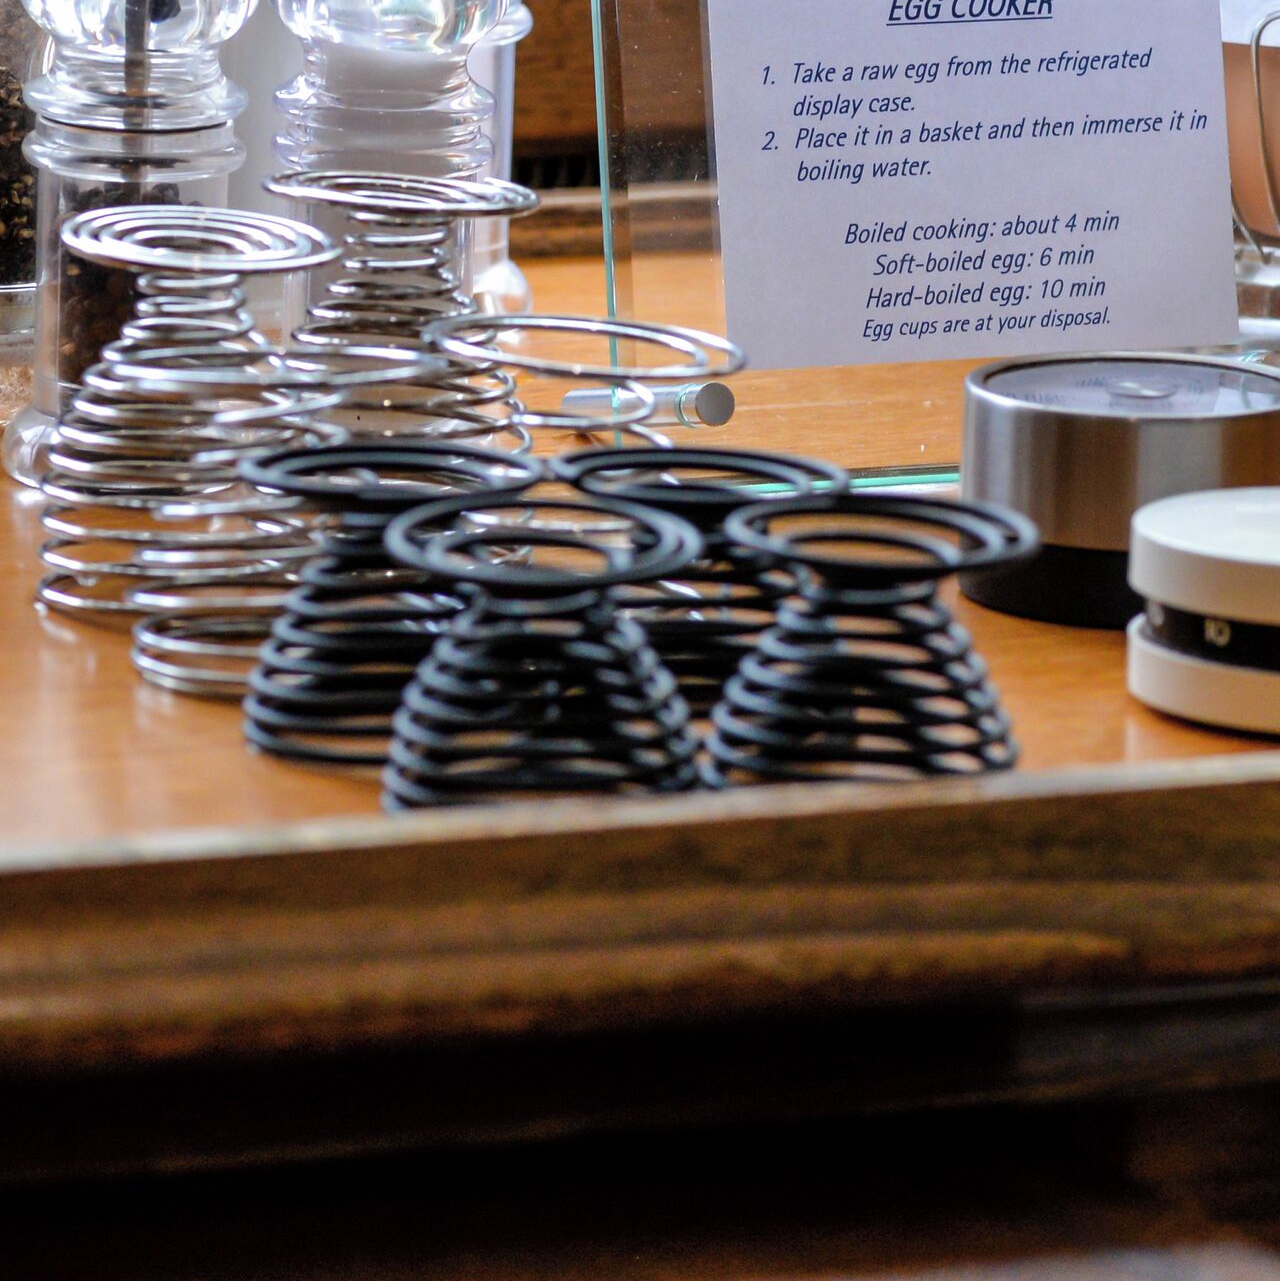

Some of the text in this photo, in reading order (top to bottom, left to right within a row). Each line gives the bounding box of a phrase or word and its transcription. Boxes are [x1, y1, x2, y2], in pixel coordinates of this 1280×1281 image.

[762, 46, 1153, 86] 1. Take a raw egg from the refrigerated
[792, 93, 916, 122] display case.
[761, 108, 1208, 151] 2. Place it in a basket and then immerse it in
[797, 157, 932, 185] boiling water.
[844, 209, 1120, 245] Boiled cooking: about 4 min
[872, 243, 1095, 276] Soft-boiled egg: 6 min
[865, 275, 1106, 310] Hard-boiled egg: 10 min
[862, 305, 1111, 343] Egg cups are at your disposal.
